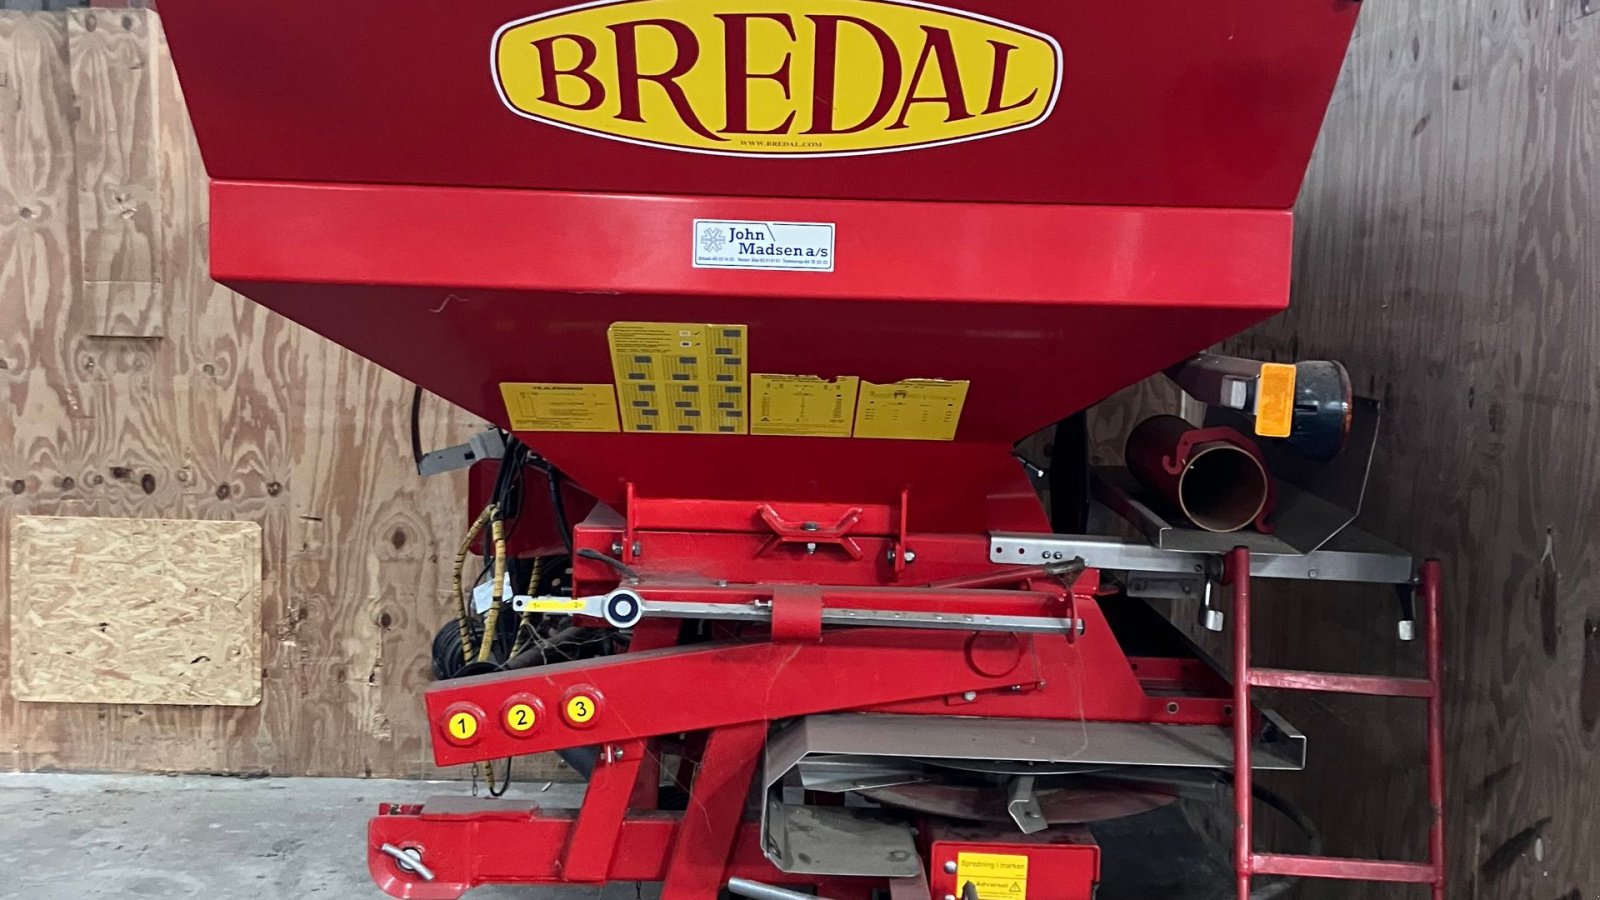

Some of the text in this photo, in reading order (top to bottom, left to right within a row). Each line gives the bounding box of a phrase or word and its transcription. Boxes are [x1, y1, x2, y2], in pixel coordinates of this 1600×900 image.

[530, 12, 1038, 141] BREDAL
[740, 140, 823, 148] WWW.BREDAL.COM
[729, 227, 765, 243] John
[738, 242, 828, 258] Madsen a/s
[457, 701, 587, 734] 1 2 3
[960, 859, 995, 869] Spredning
